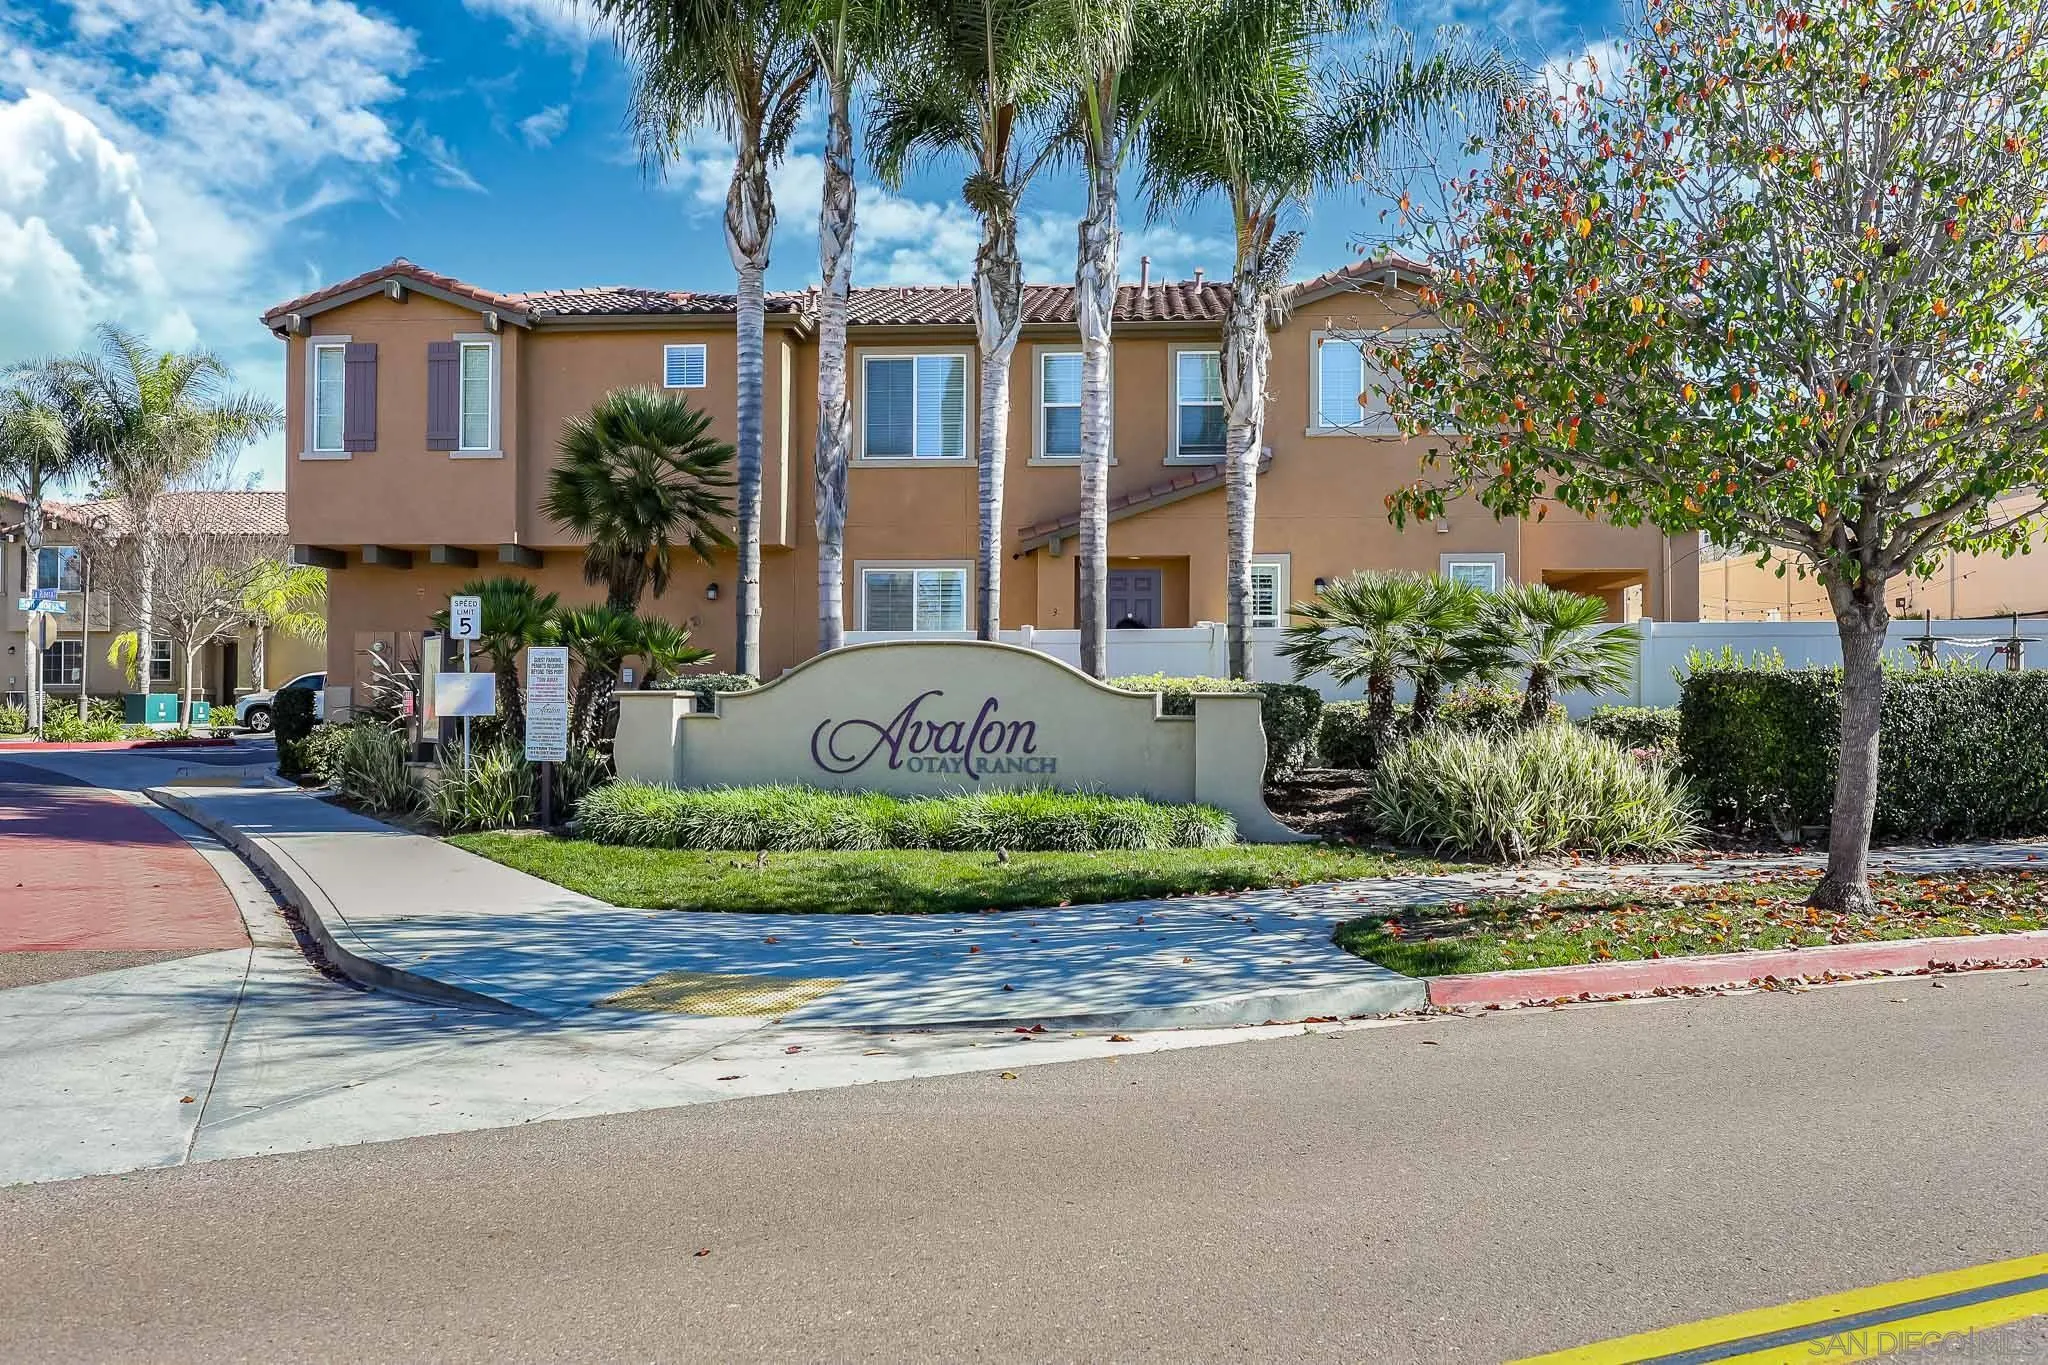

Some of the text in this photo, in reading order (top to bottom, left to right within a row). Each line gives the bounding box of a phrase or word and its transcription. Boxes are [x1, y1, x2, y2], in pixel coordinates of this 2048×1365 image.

[460, 617, 471, 635] 5
[811, 690, 1037, 780] Avalon
[907, 757, 1057, 773] OTAY RANCH
